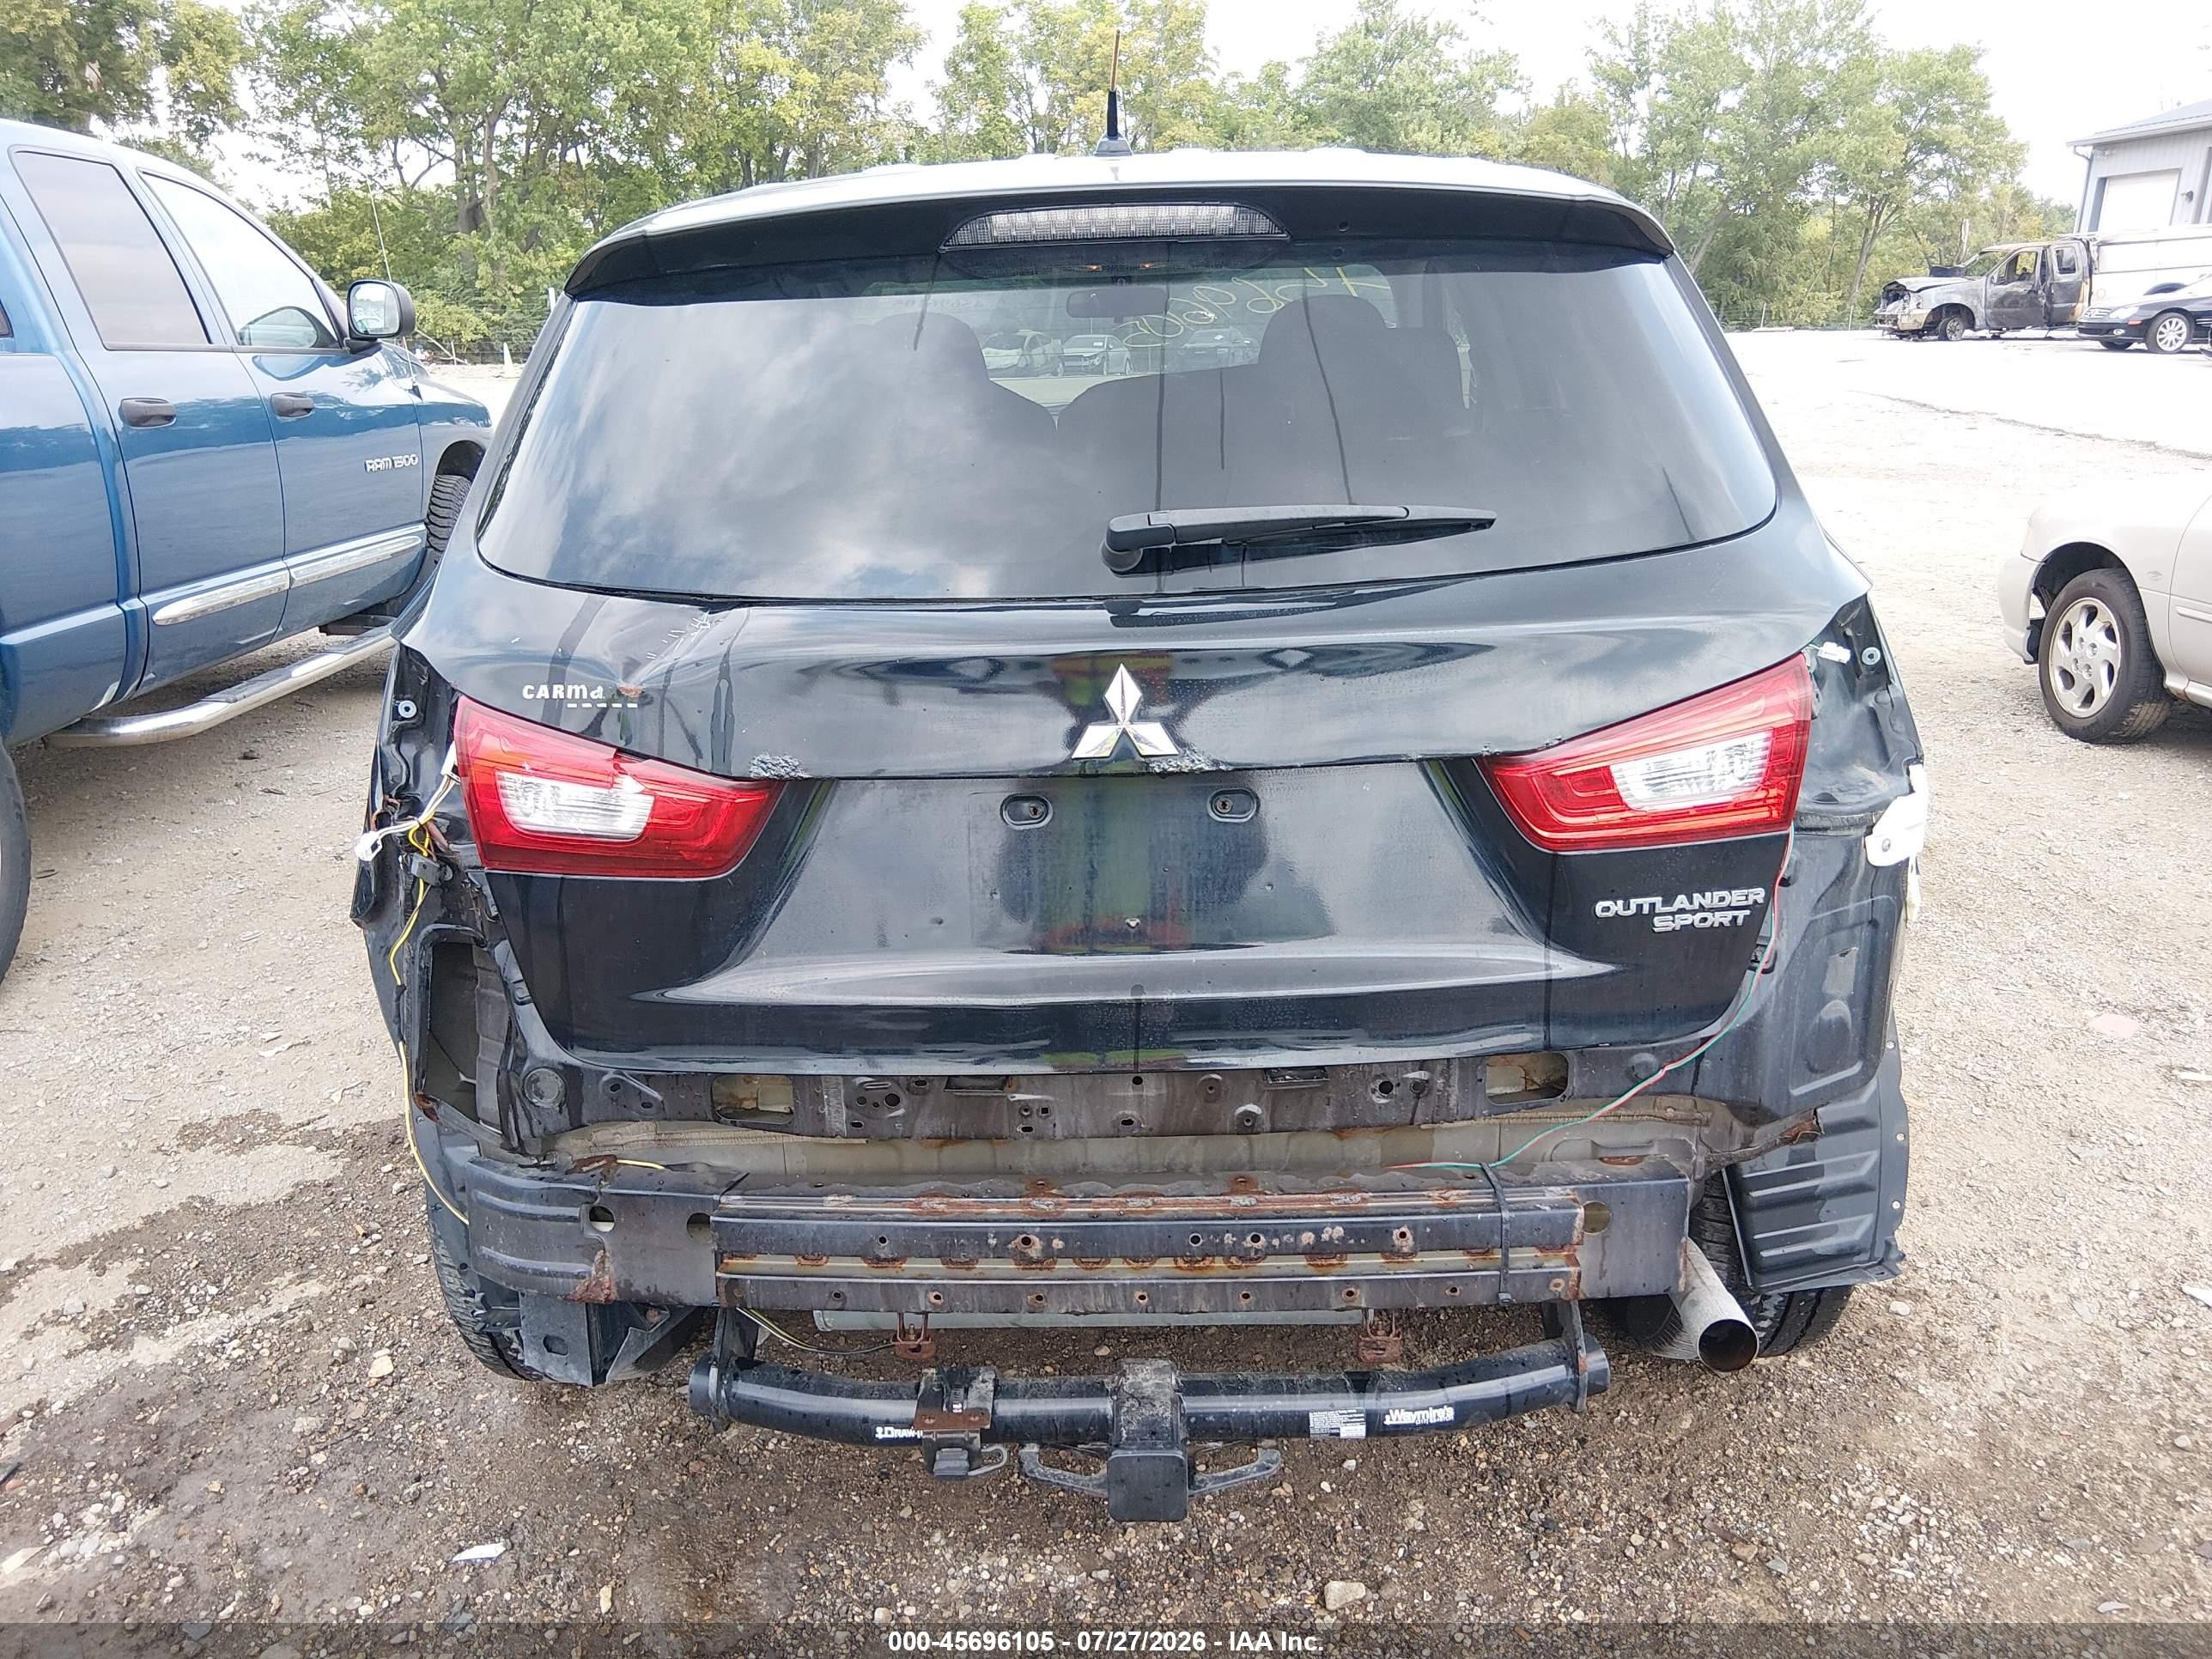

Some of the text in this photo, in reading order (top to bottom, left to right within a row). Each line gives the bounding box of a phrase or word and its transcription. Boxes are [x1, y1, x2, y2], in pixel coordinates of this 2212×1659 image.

[365, 454, 418, 472] RAM 1500
[1595, 888, 1765, 918] OUTLANDER
[1652, 910, 1751, 933] SPORT
